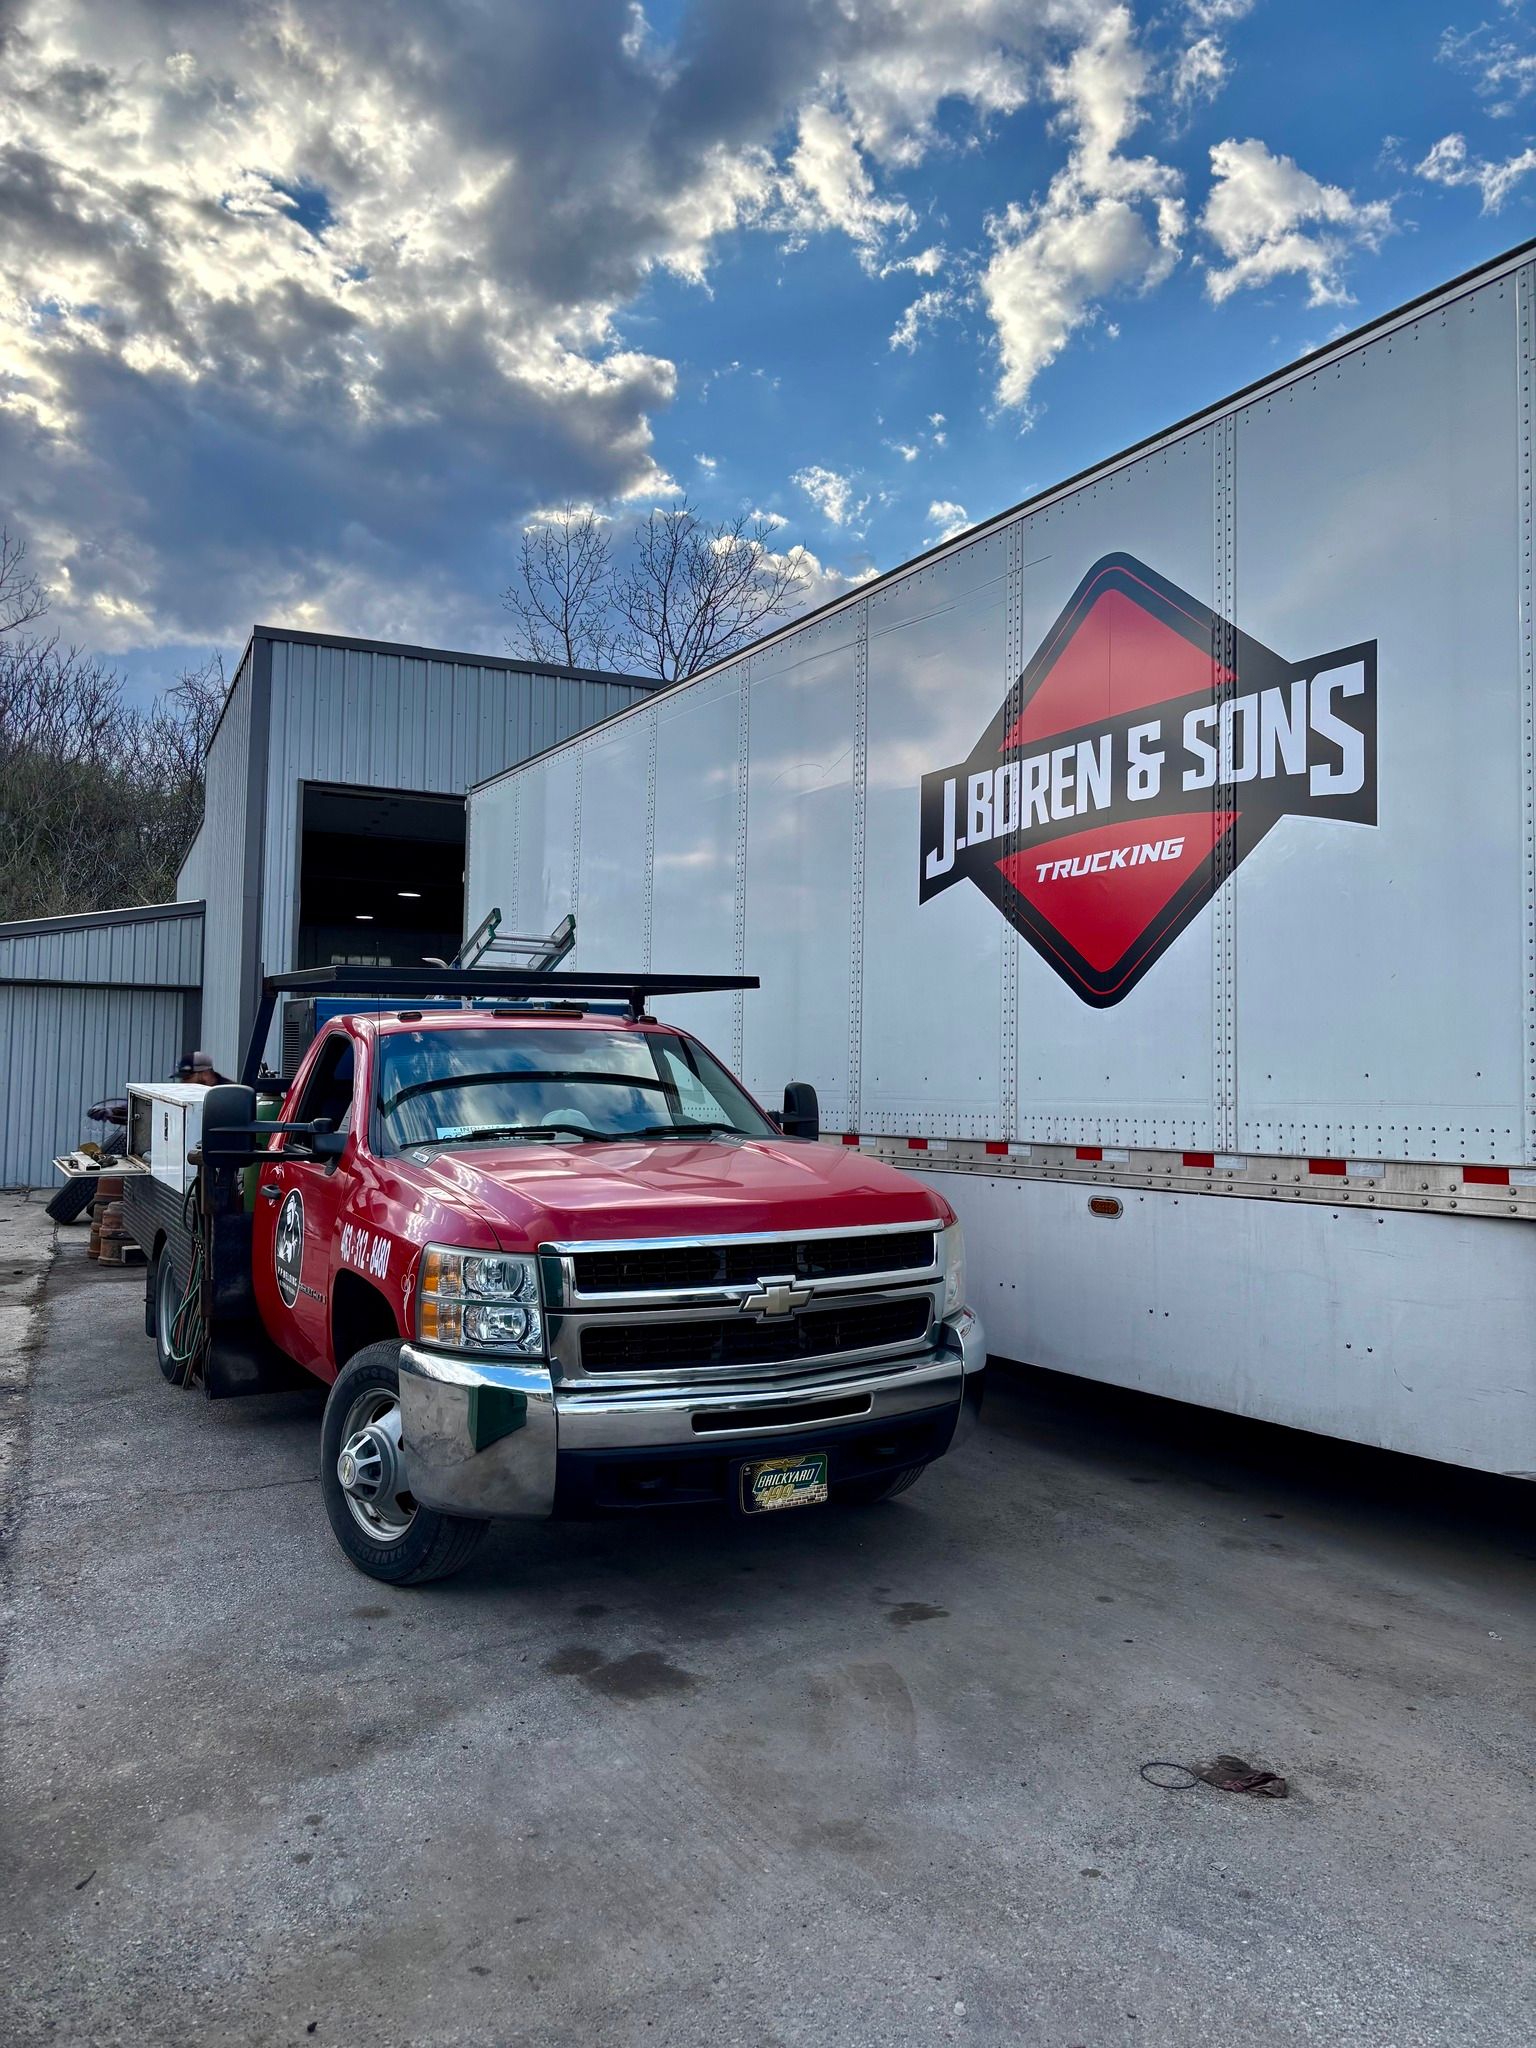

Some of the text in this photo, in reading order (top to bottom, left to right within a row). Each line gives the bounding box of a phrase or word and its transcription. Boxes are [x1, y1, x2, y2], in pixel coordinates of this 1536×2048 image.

[1127, 720, 1166, 801] &
[1182, 660, 1365, 797] SONS
[1036, 837, 1185, 883] TRUCKING
[757, 1468, 816, 1488] BRICKYARD
